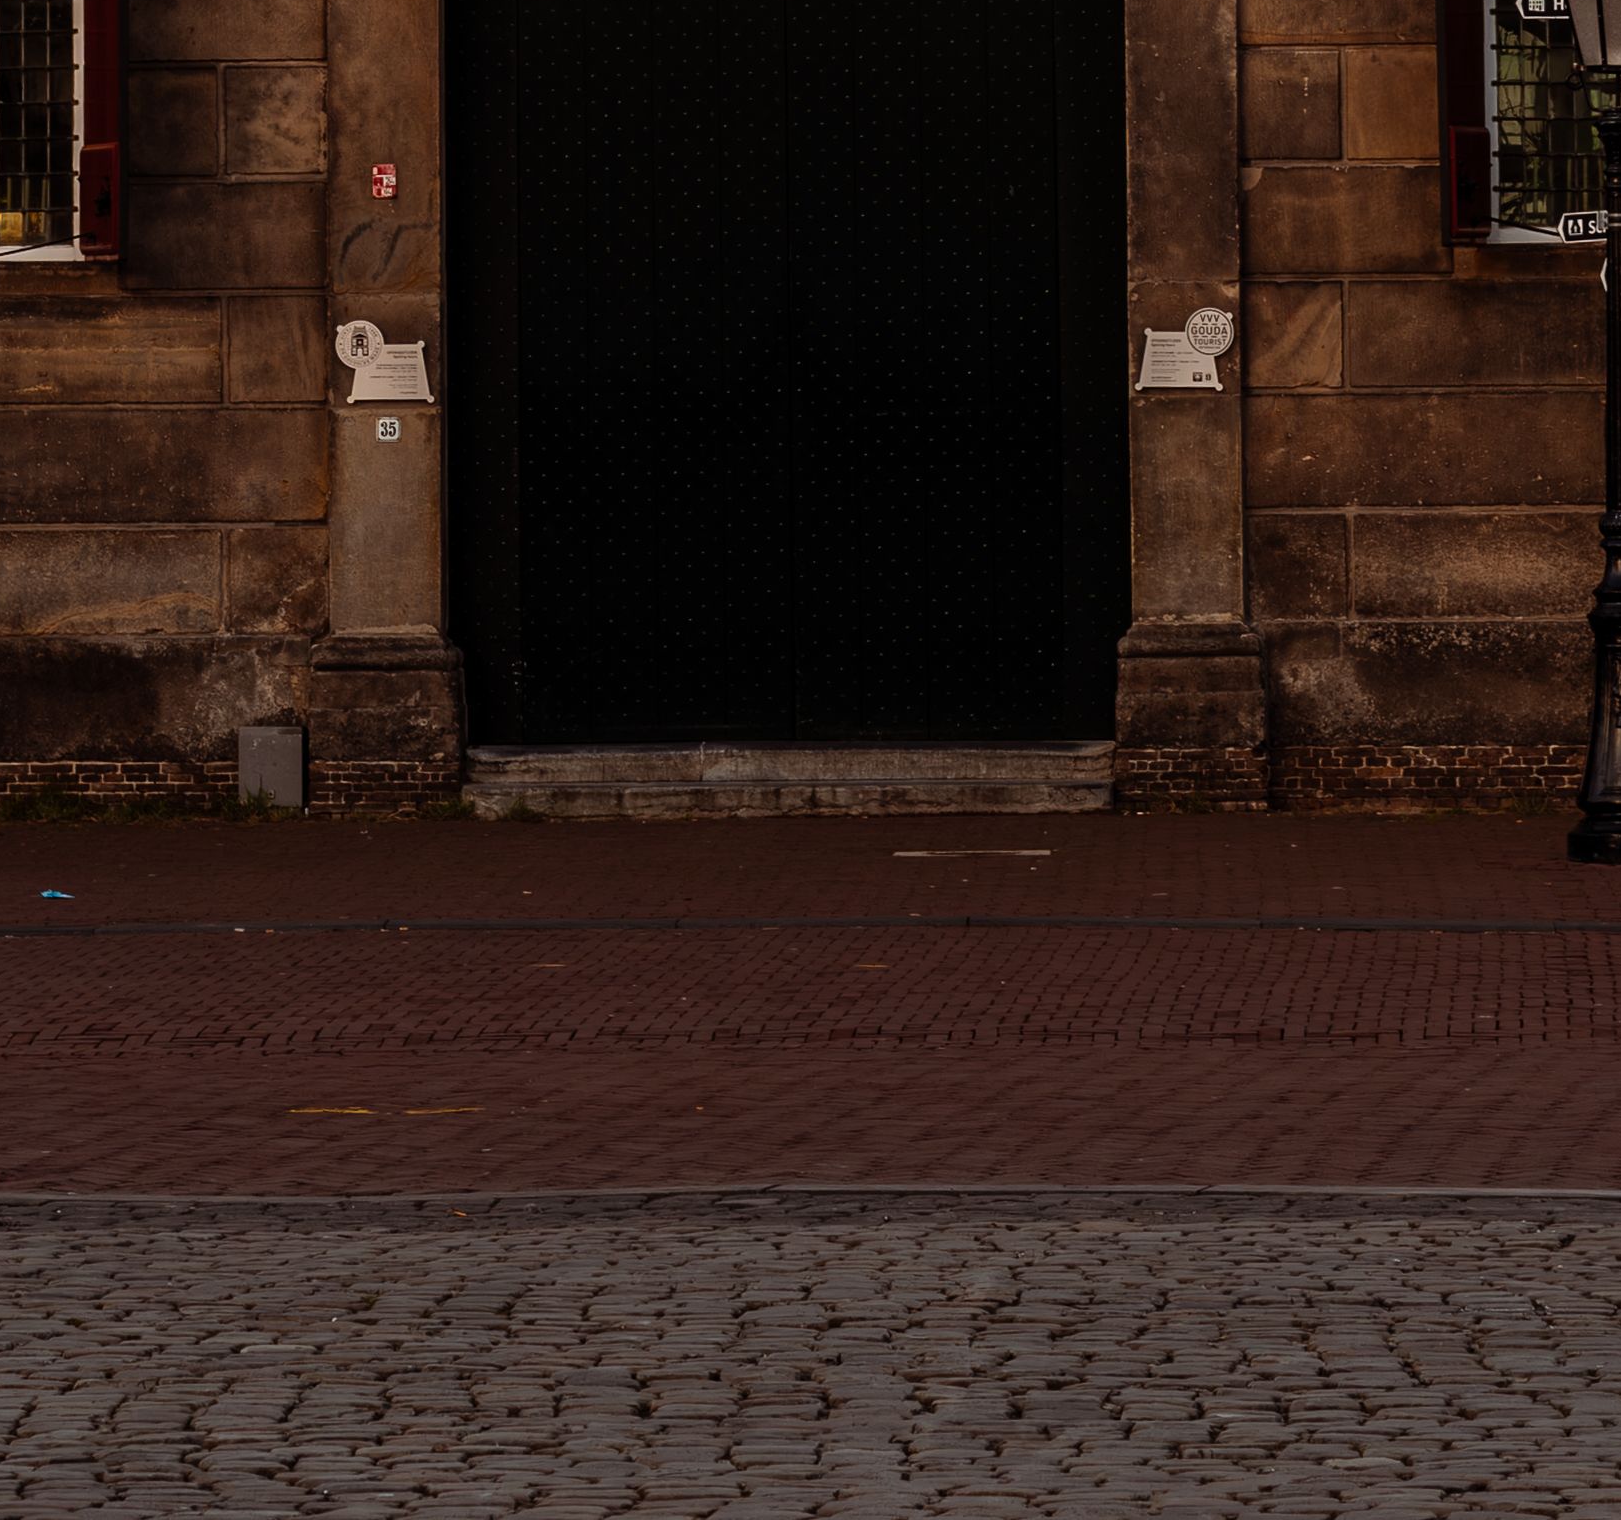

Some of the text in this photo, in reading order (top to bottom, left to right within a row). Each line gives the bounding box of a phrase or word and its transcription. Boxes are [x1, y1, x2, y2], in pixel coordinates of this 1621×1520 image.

[1199, 314, 1220, 323] VVV
[1191, 326, 1228, 335] GOUDA
[1194, 338, 1226, 346] TOURIST
[380, 421, 397, 437] 35
